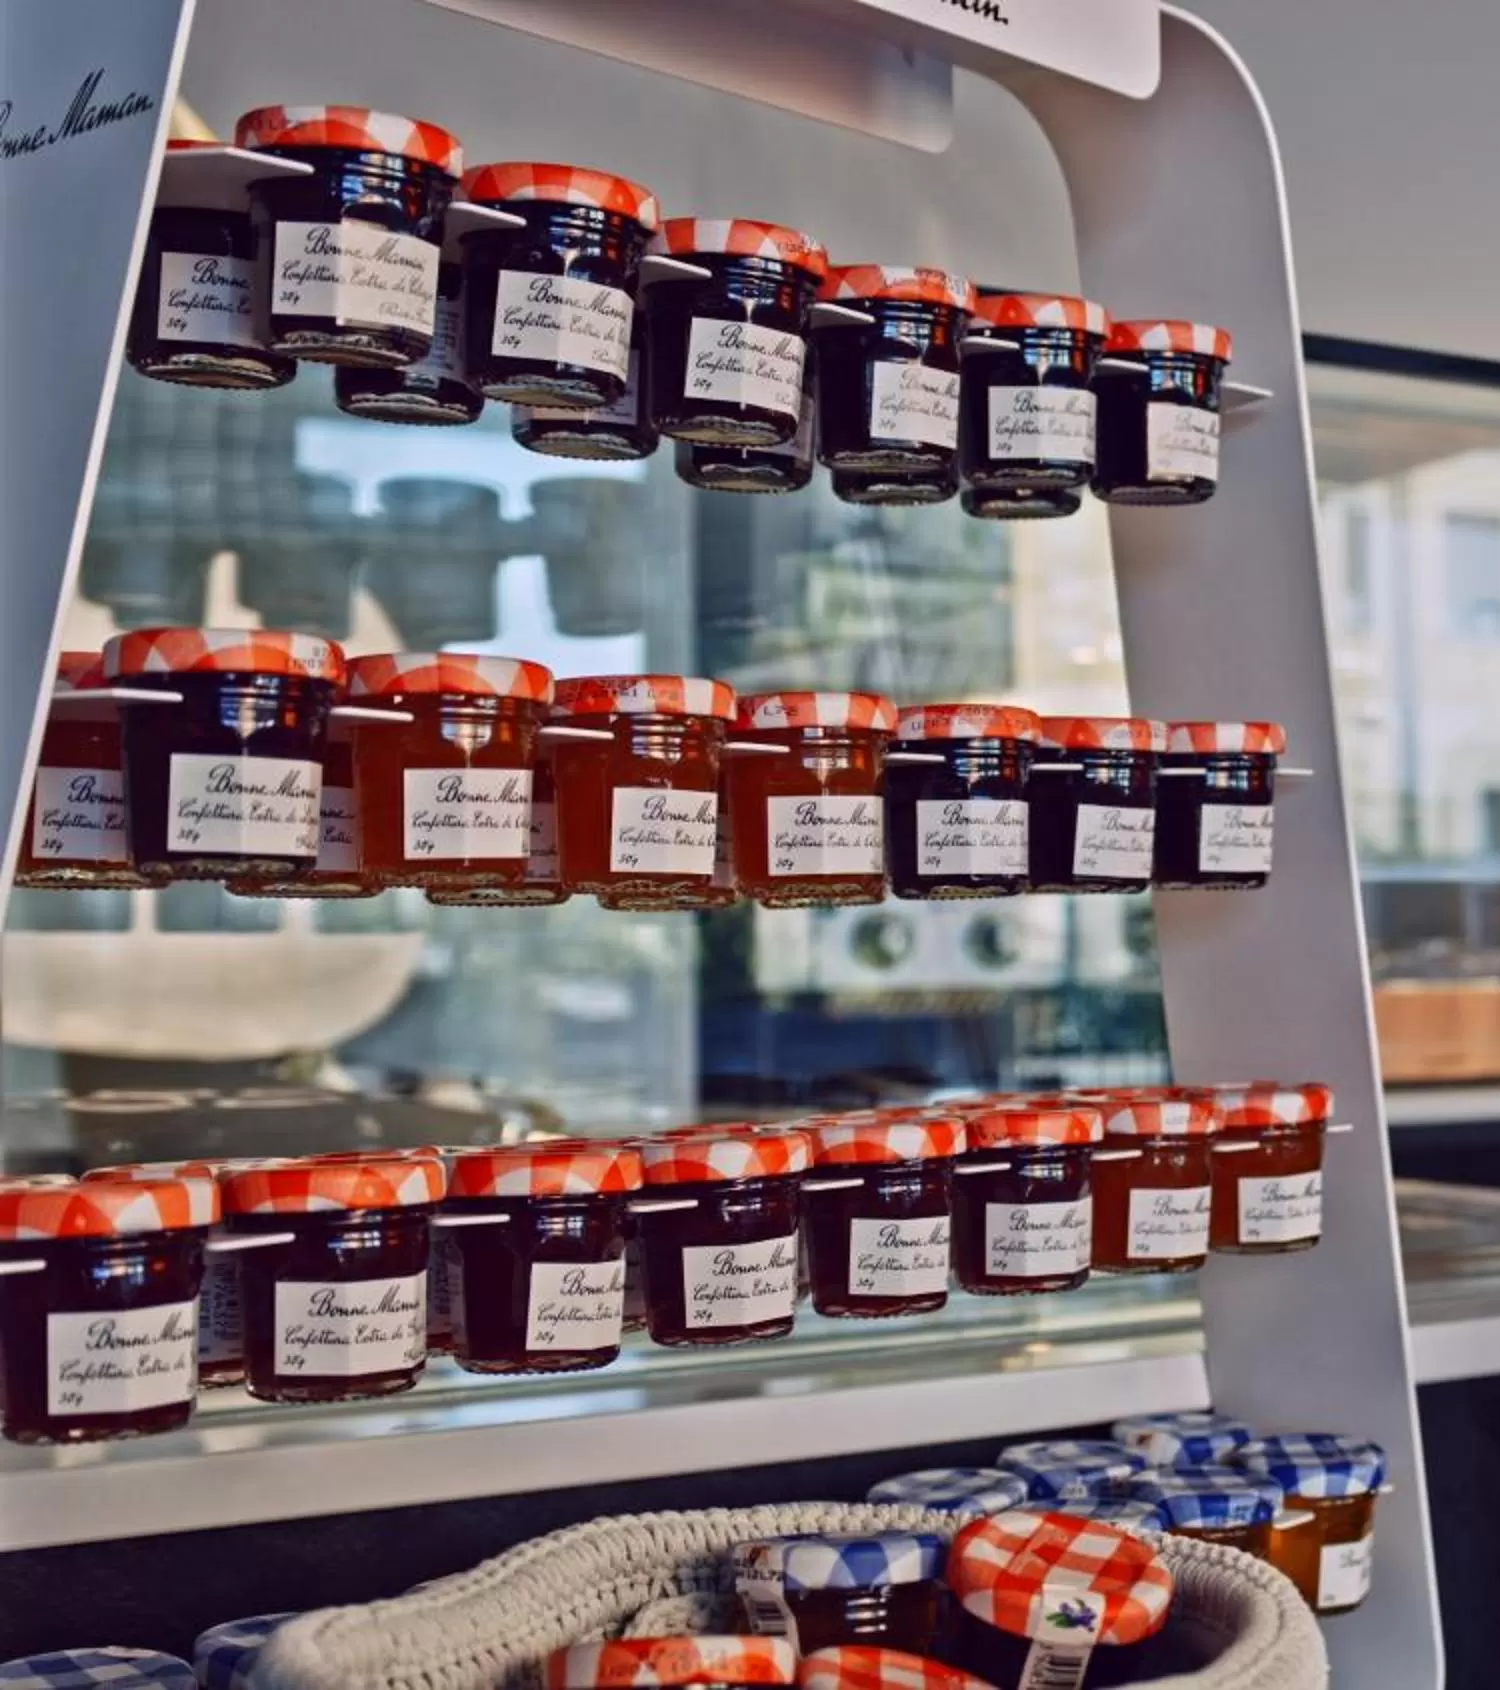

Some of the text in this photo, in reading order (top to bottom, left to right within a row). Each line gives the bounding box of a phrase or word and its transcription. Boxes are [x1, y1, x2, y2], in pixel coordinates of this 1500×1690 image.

[0, 67, 153, 158] nne Maman
[304, 227, 362, 257] Bonne
[527, 278, 581, 308] Bonne
[717, 325, 765, 353] Bonne
[205, 763, 268, 795] Bonne
[436, 775, 491, 804] Bonne
[641, 795, 690, 821] Bonne
[794, 801, 846, 827] Bonne
[941, 803, 988, 826] Bonne
[877, 1223, 922, 1249] Bonne
[712, 1249, 763, 1277] Bonne
[560, 1268, 606, 1296] Bonne
[308, 1288, 370, 1317] Bonne
[85, 1318, 150, 1351] Bonne
